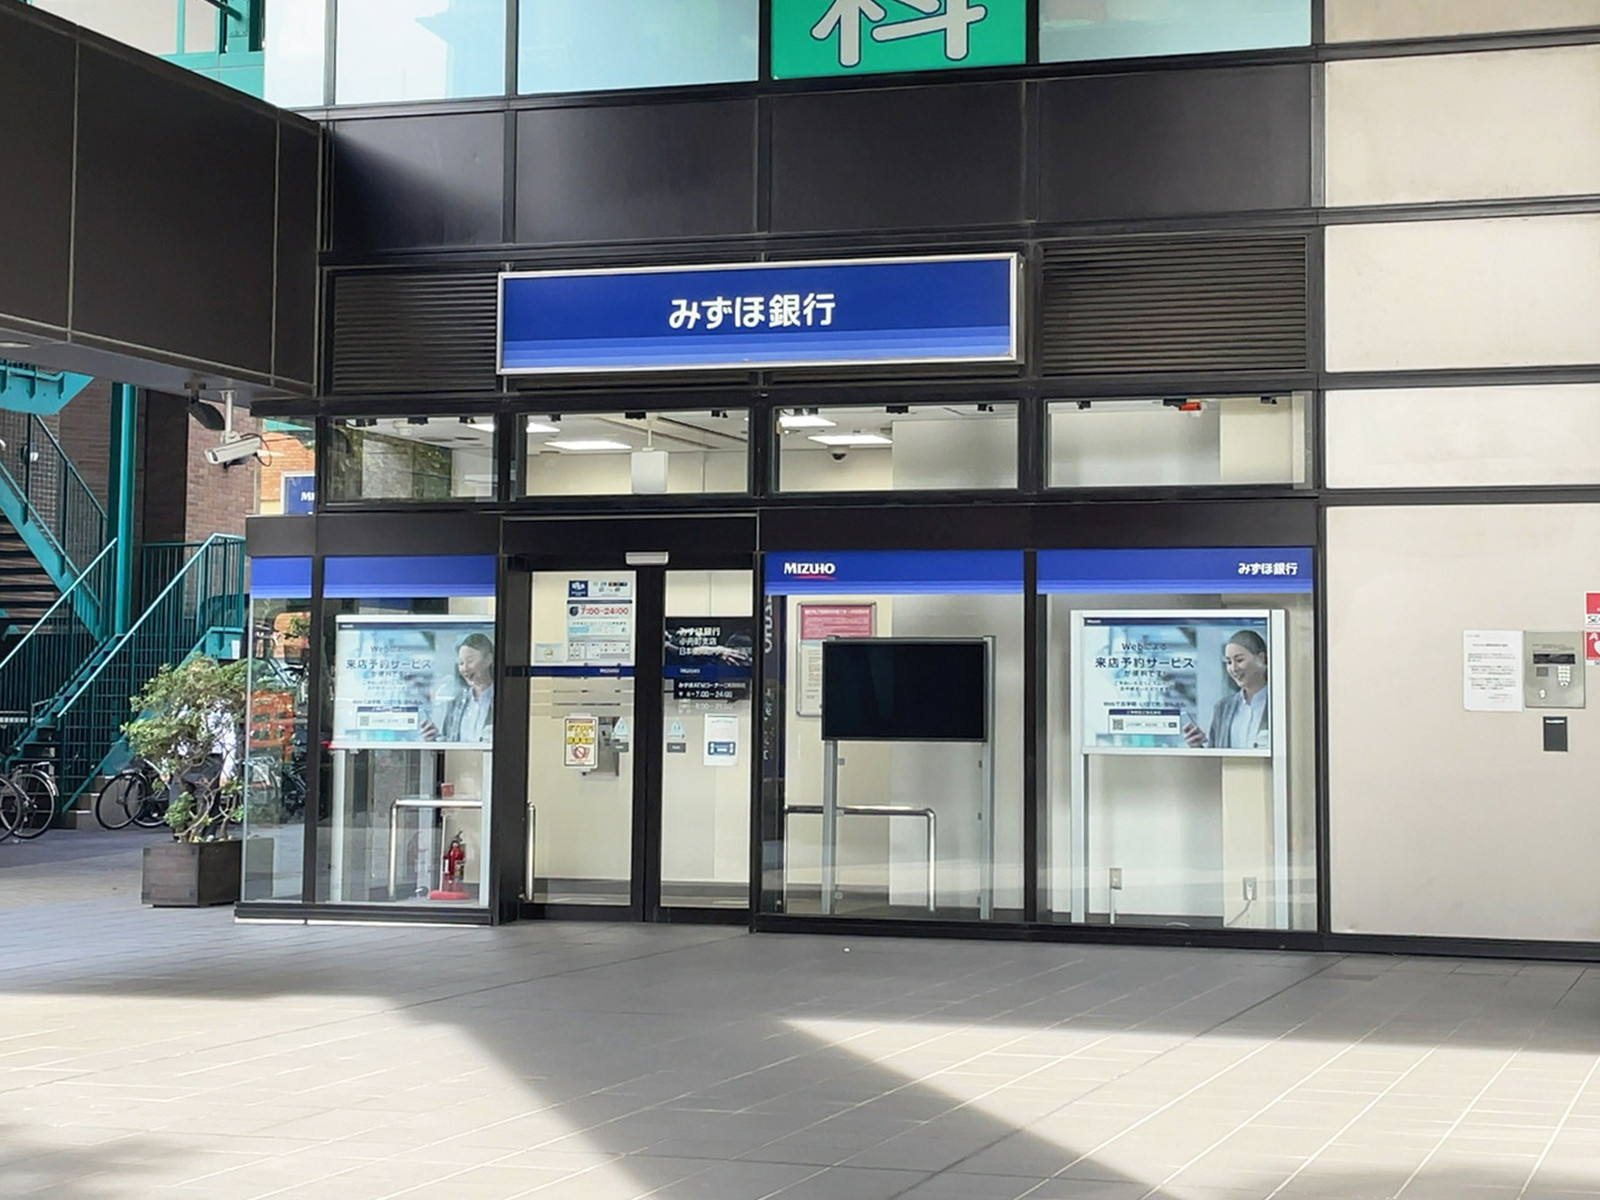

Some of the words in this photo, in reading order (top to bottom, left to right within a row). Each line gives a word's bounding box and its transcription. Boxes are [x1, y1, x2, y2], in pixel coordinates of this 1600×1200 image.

[668, 292, 836, 330] みずほ銀行
[783, 562, 836, 575] MIZUHO
[1237, 562, 1298, 575] みずほ銀行
[346, 659, 432, 670] 来店予約サービス
[1094, 657, 1195, 669] 来店予約サービス
